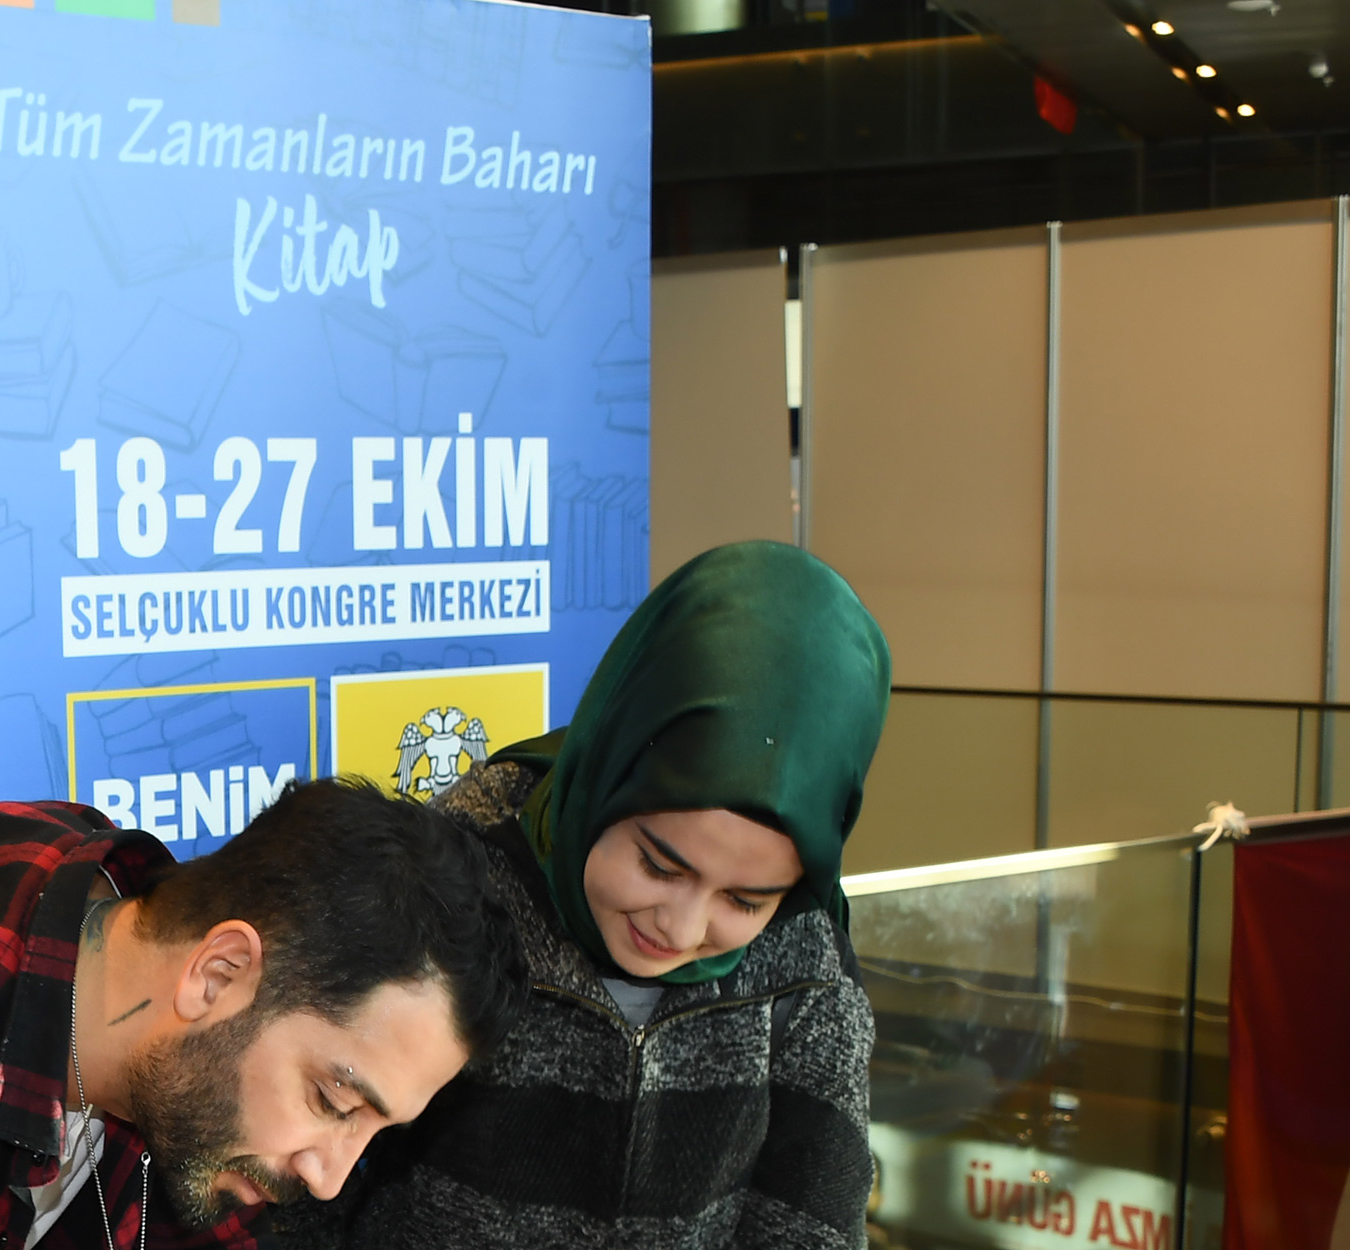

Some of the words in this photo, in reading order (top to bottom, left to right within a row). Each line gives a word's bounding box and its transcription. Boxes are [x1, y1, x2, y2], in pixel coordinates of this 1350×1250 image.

[118, 97, 426, 183] Zamanların
[439, 125, 598, 195] Baharı
[232, 193, 401, 316] Kitap
[58, 436, 318, 560] 18-27
[352, 412, 549, 551] EKİM
[70, 588, 250, 643] SELÇUKLU
[265, 583, 398, 631] KONGRE
[410, 569, 543, 624] MERKEZİ
